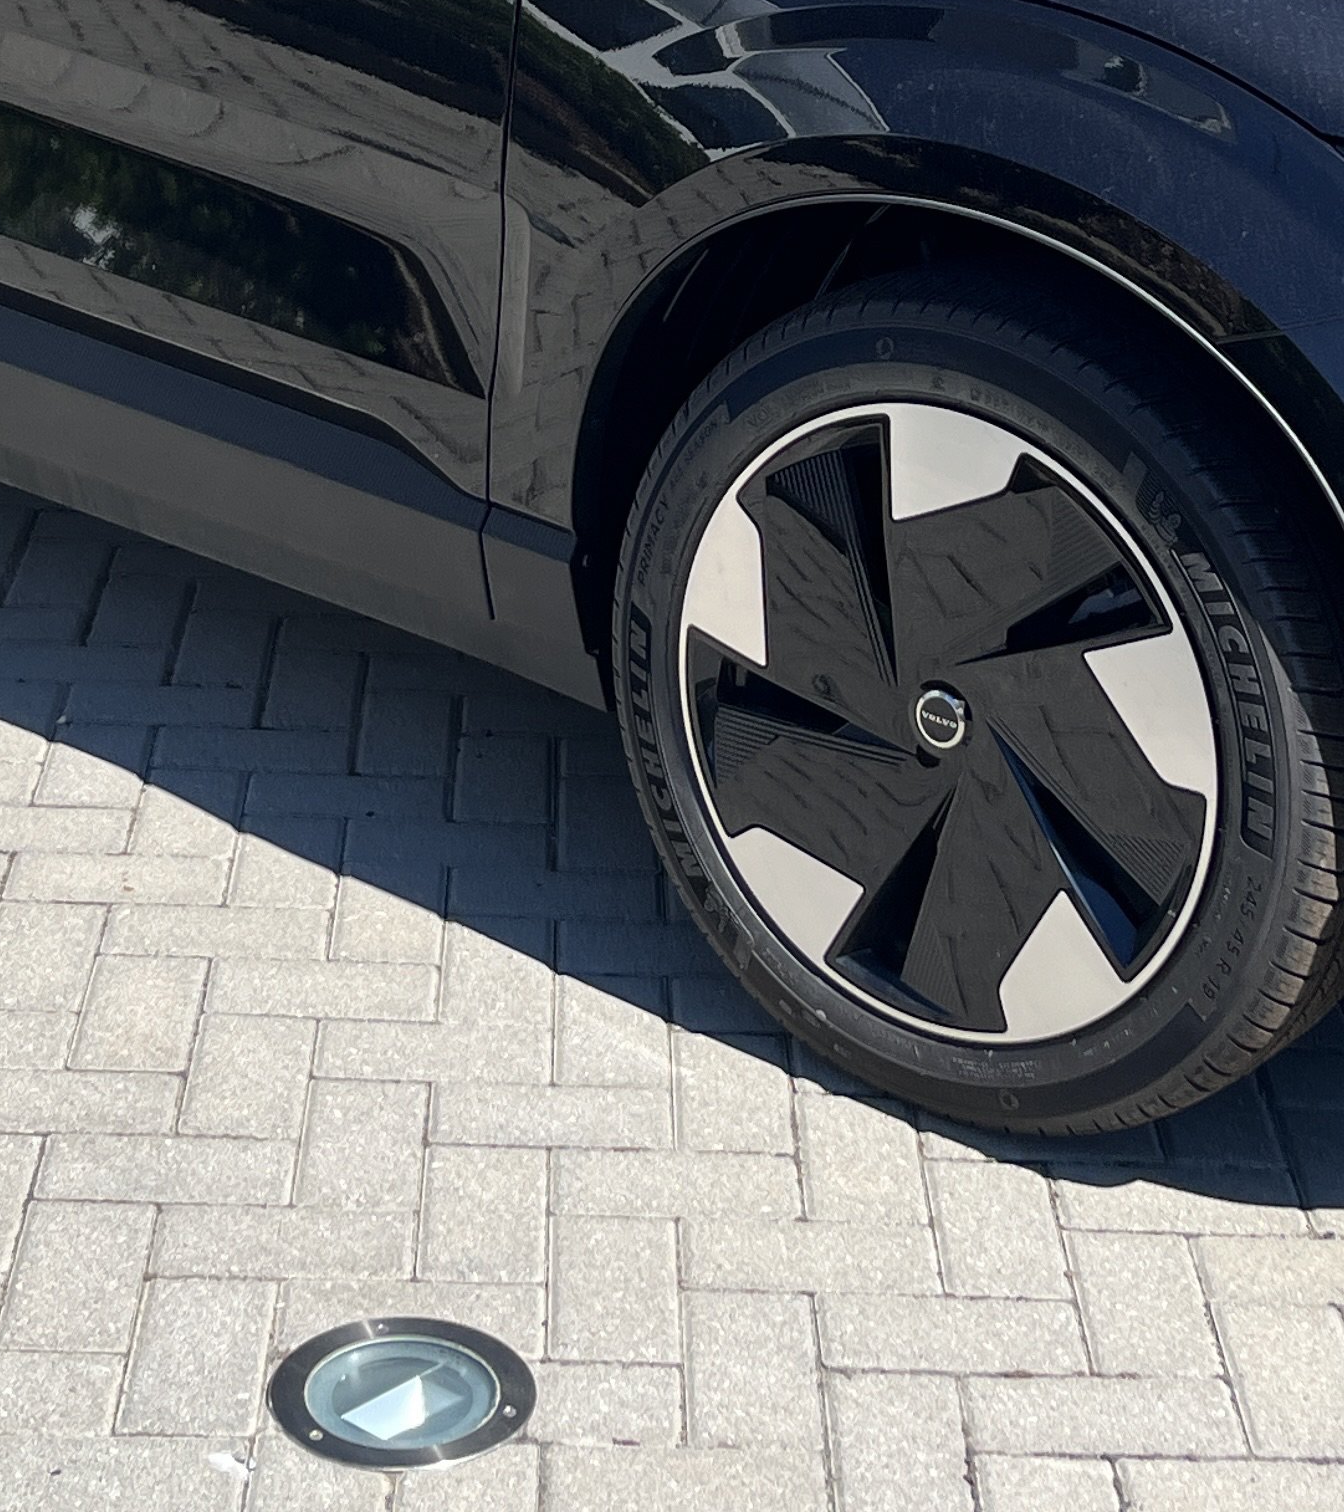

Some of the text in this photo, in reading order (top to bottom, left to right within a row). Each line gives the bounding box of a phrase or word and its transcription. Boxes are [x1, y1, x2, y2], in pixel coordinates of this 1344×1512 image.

[637, 492, 670, 586] PRIMACY
[629, 626, 704, 879] MICHELIN
[921, 710, 958, 729] VOLVO
[1180, 551, 1275, 841] MICHELIN
